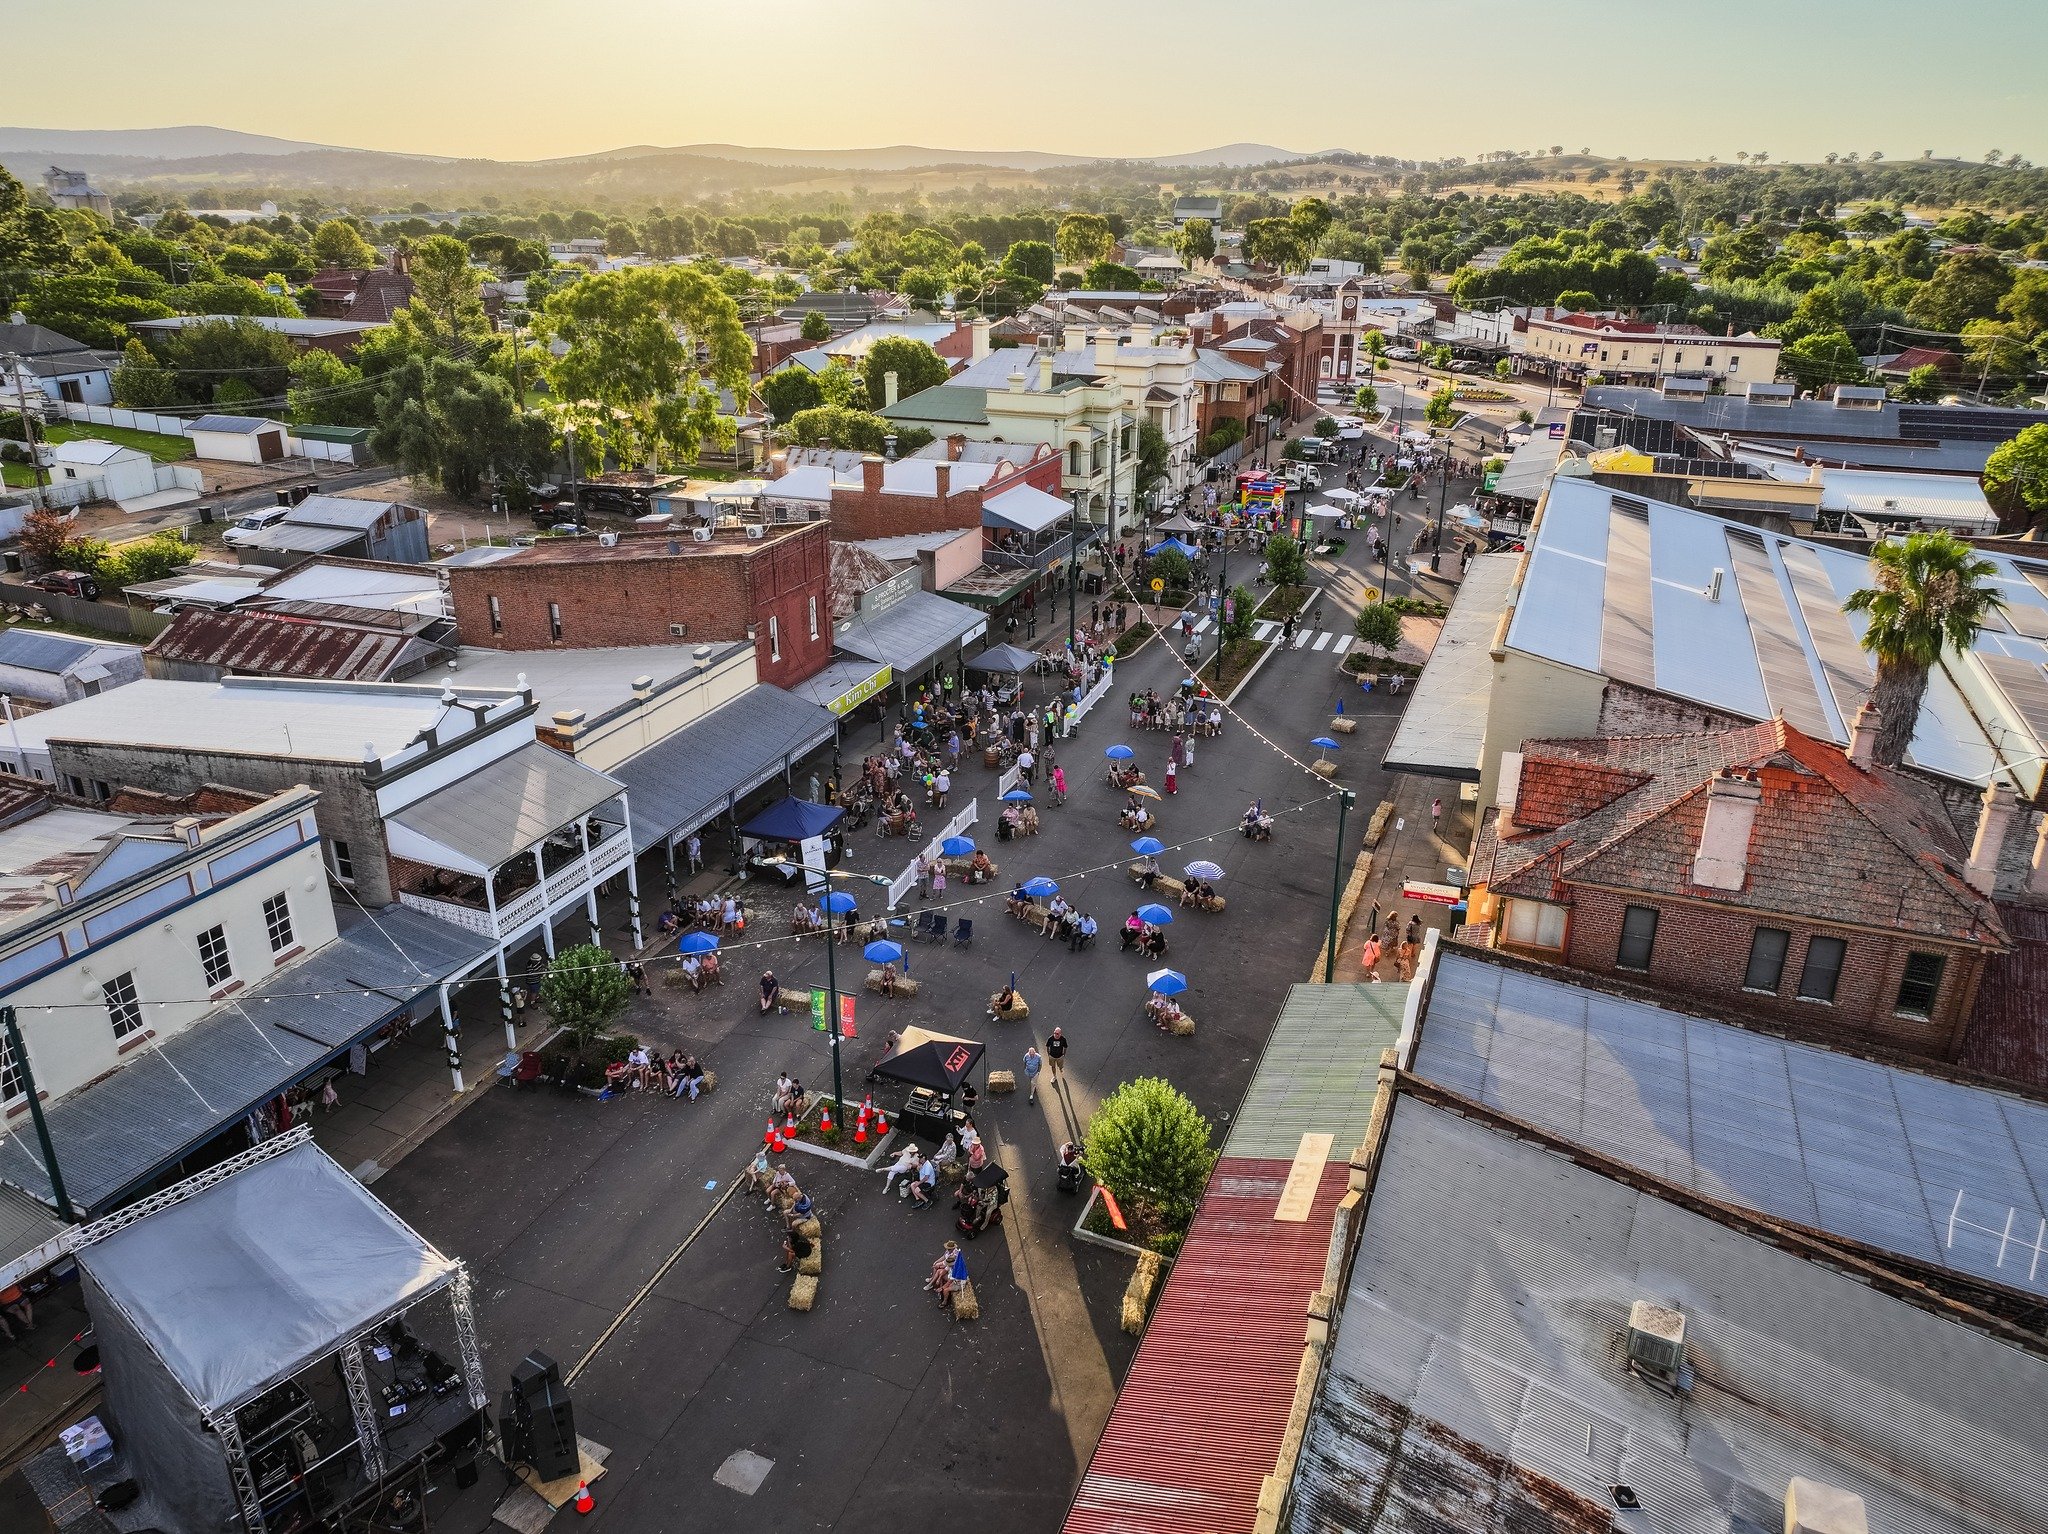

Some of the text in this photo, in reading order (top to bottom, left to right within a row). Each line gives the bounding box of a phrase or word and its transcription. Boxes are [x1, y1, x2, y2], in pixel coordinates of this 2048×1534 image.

[845, 676, 877, 706] Kim Chi
[674, 797, 728, 840] GRENFELL PHARMACY
[1283, 1161, 1318, 1218] FRUIT
